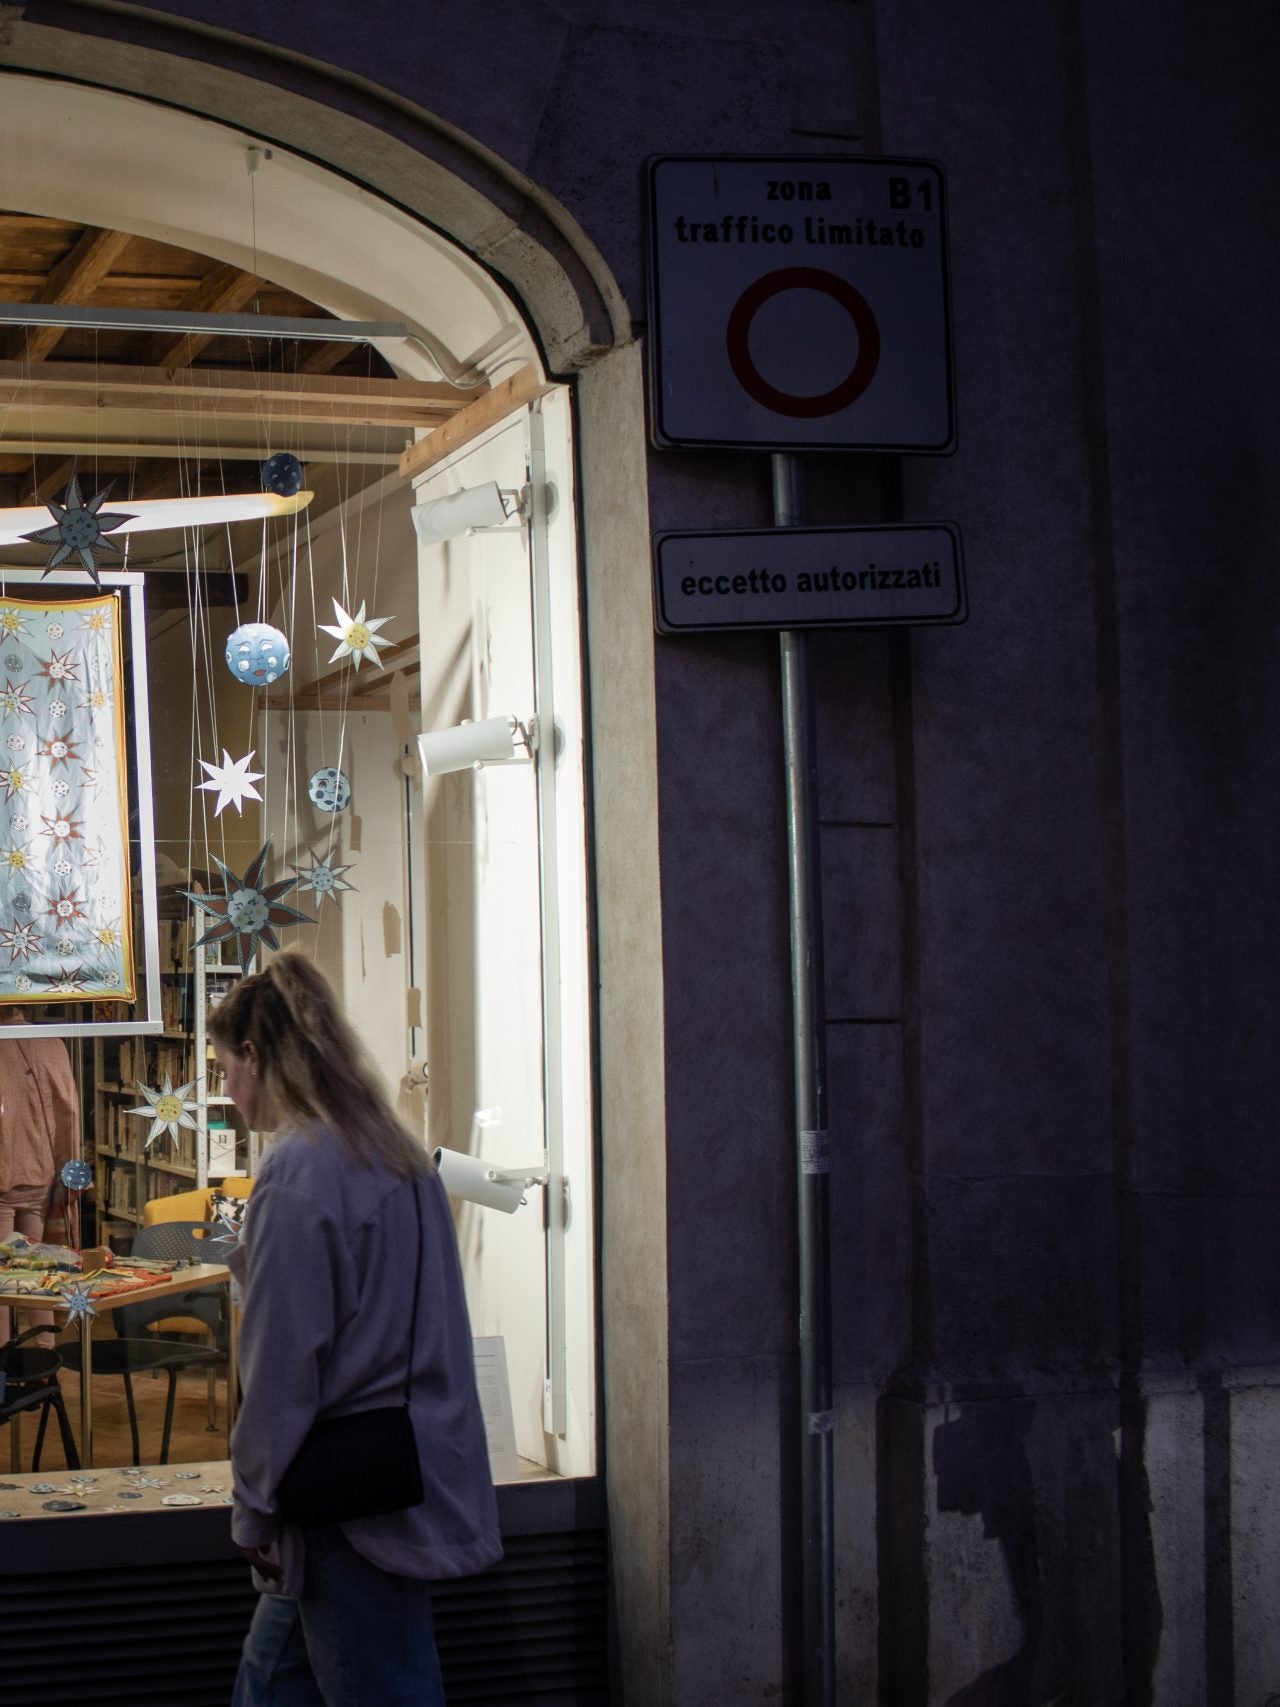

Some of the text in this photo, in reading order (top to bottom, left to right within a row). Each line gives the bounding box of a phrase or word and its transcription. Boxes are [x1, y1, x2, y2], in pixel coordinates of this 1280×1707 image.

[766, 180, 832, 201] zona
[674, 215, 925, 248] traffico limitato
[680, 561, 941, 596] eccetto autorizzati
